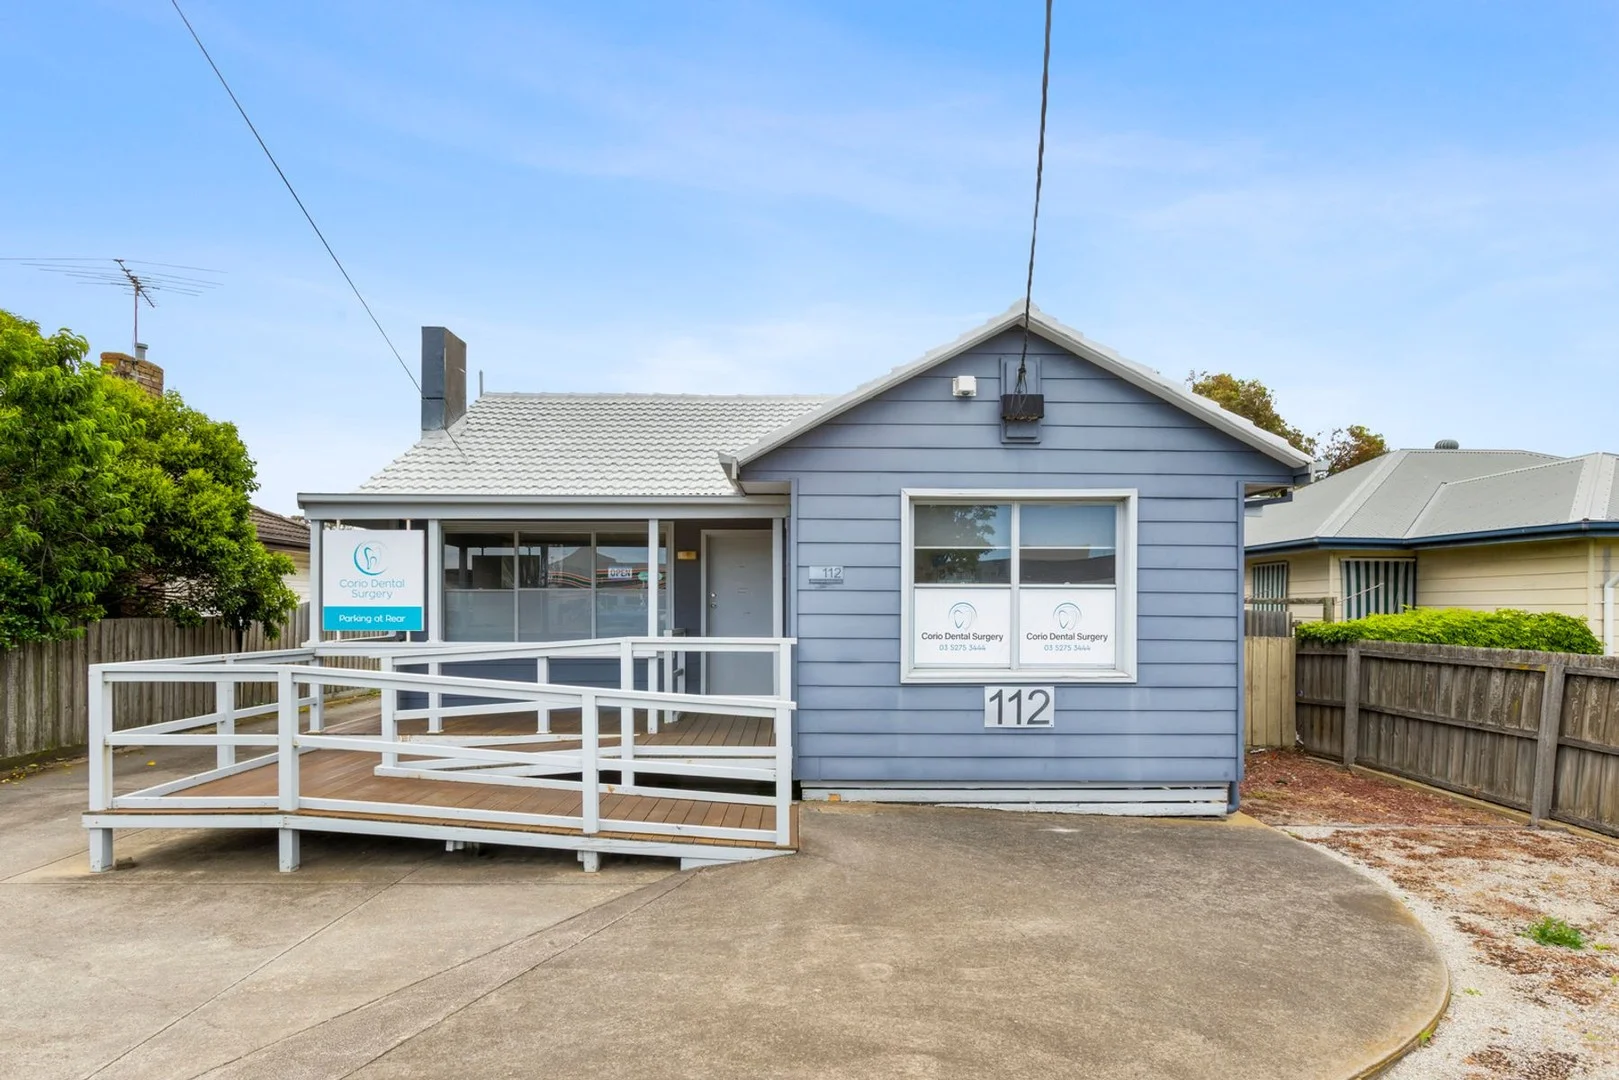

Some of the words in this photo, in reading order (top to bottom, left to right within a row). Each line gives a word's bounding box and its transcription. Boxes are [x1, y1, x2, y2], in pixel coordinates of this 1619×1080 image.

[610, 568, 631, 577] OPEN
[822, 567, 842, 578] 112
[339, 579, 368, 588] Corio
[371, 579, 405, 588] Dental
[352, 589, 393, 600] Surgery
[339, 614, 372, 623] Parking
[386, 614, 406, 622] Rear
[921, 632, 944, 640] Corio
[945, 632, 971, 640] Dental
[972, 632, 1004, 642] Surgery
[1026, 632, 1048, 641] Corio
[1049, 632, 1075, 641] Dental
[1077, 632, 1108, 642] Surgery
[989, 688, 1051, 725] 112
